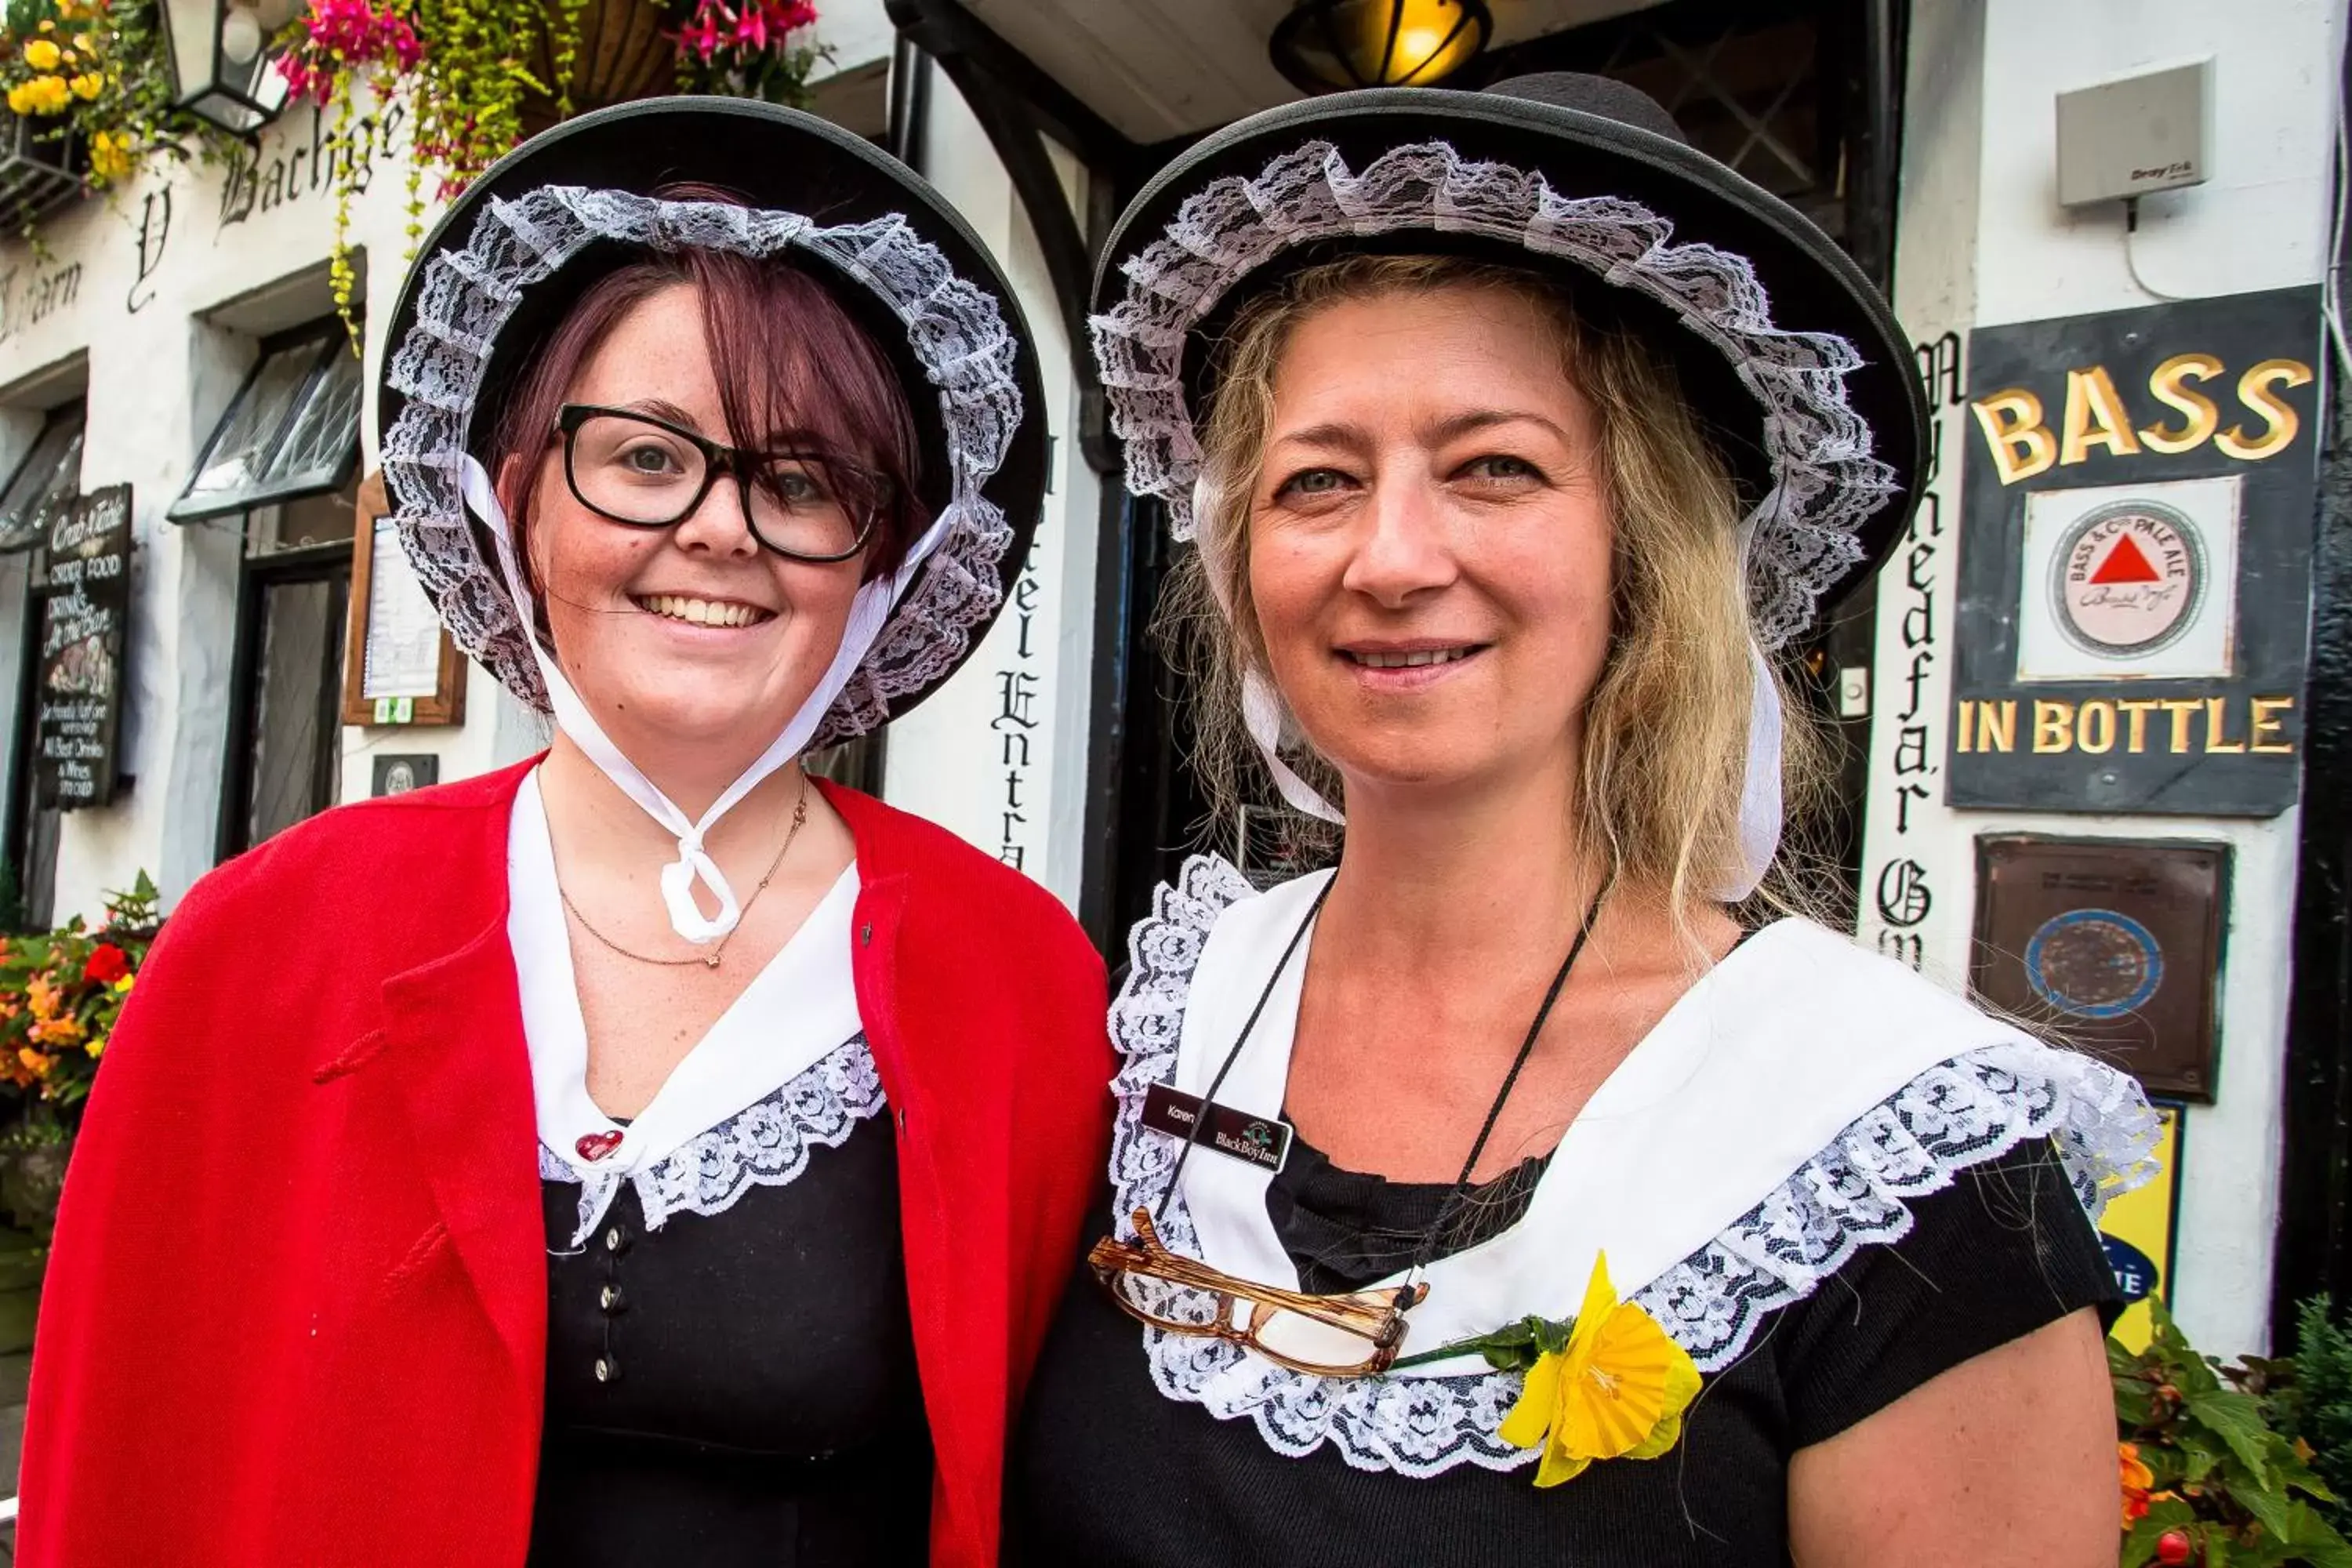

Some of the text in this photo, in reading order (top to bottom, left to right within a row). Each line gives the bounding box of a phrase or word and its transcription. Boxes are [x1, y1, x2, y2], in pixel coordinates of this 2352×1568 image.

[1971, 353, 2314, 486] BASS
[87, 554, 122, 580] FOOD
[2071, 544, 2096, 581] BASS
[2091, 531, 2107, 542] &
[2134, 518, 2175, 546] PALE
[2164, 549, 2187, 578] ALE
[1957, 696, 2293, 754] IN BOTTLE
[1167, 1104, 1196, 1123] Karen
[1215, 1131, 1279, 1164] Black Boy Inn
